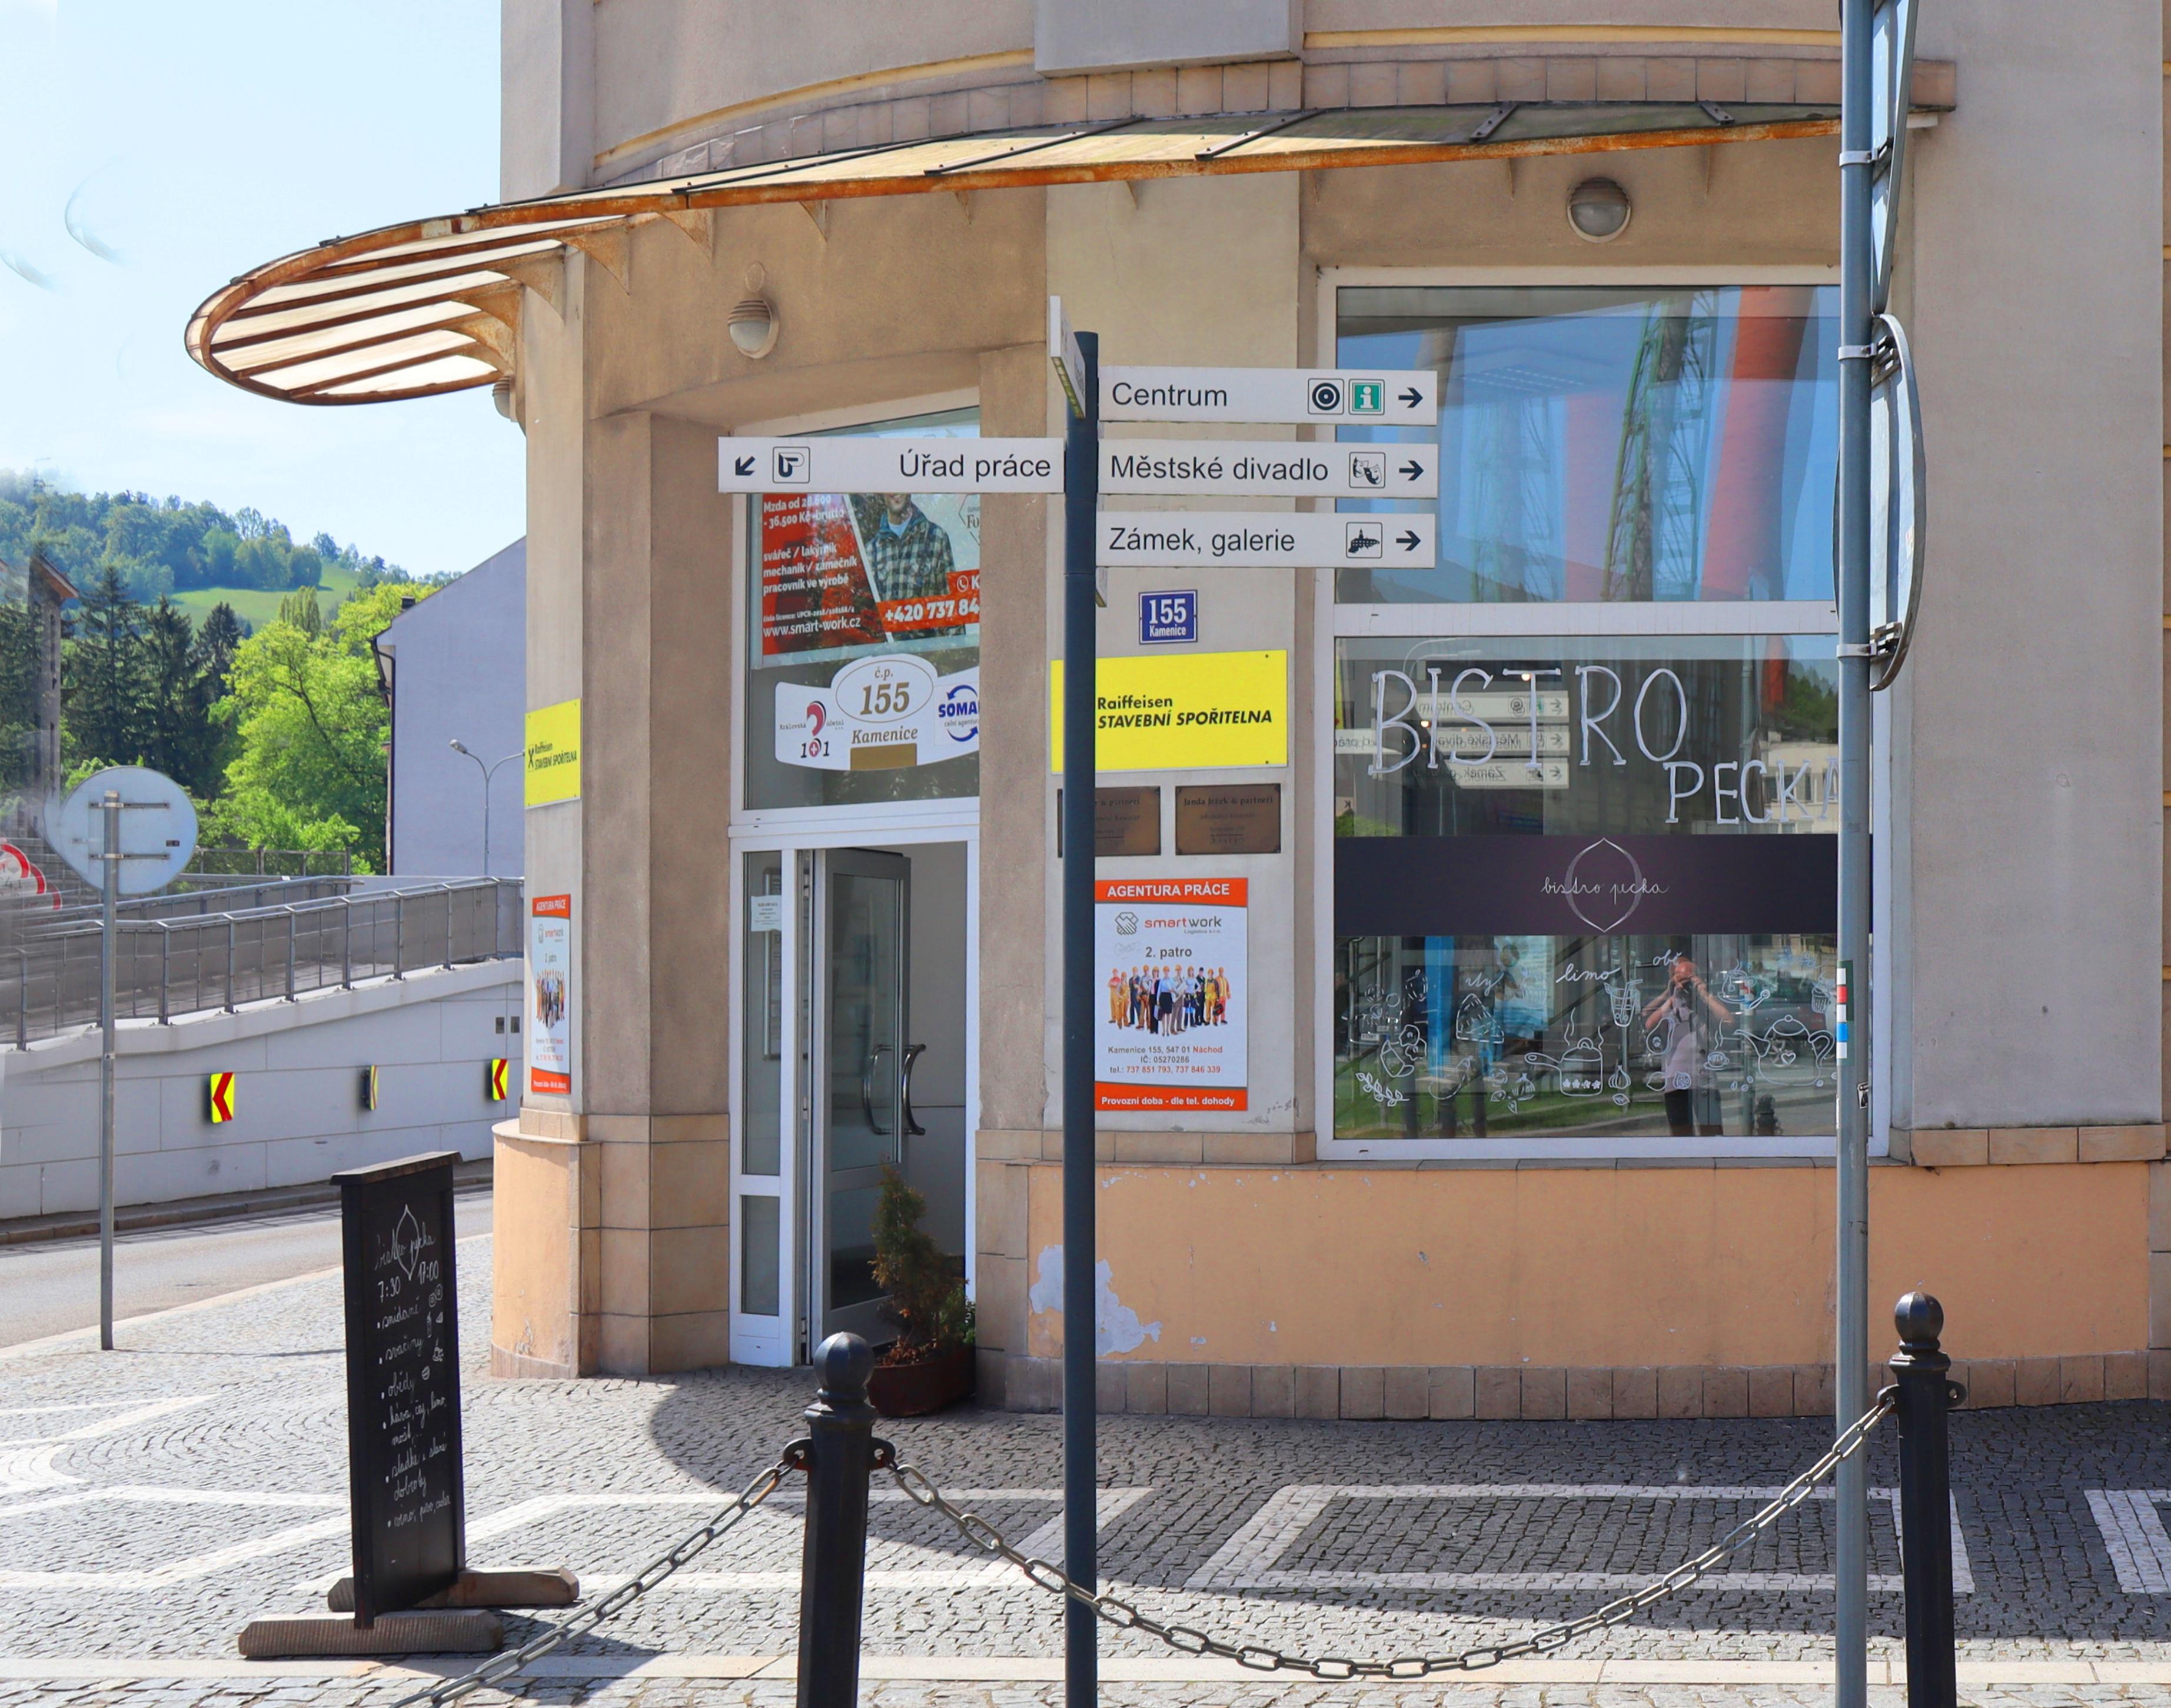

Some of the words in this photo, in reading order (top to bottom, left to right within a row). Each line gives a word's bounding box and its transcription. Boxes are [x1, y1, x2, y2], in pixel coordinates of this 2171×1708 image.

[1111, 381, 1228, 407] Centrum
[899, 448, 964, 477] Úřad
[975, 452, 1051, 482] práce
[1110, 455, 1223, 480] Městské
[1233, 457, 1328, 481] divadlo
[763, 500, 786, 512] Mzda
[788, 497, 801, 510] od
[769, 515, 797, 529] 36.500
[1109, 527, 1202, 555] Zámek,
[1211, 530, 1295, 557] galerie
[763, 548, 792, 562] svářeč
[763, 562, 805, 578] mechanik
[816, 556, 857, 571] zámečník
[763, 577, 806, 597] pracovník
[806, 580, 817, 588] ve
[819, 573, 849, 589] výrobě
[885, 603, 923, 622] +420
[926, 600, 955, 619] 737
[1148, 598, 1187, 625] 155
[763, 616, 861, 638] www.smart-work.cz
[1149, 624, 1186, 637] Kamenice
[874, 665, 893, 679] č.p.
[859, 682, 910, 715] 155
[1098, 694, 1173, 710] Raiffeisen
[938, 701, 980, 718] SOMA
[1098, 710, 1171, 728] STAVEBNÍ
[1176, 707, 1272, 726] SPOŘITELNA
[1368, 665, 1689, 776] BISTRO
[852, 725, 918, 744] Kamenice
[1184, 797, 1206, 806] Janda
[1240, 795, 1274, 806] partneři
[1107, 885, 1181, 897] AGENTURA
[1184, 881, 1230, 895] PRÁCE
[1541, 876, 1605, 894] bistro
[1610, 877, 1670, 906] pecka
[1144, 915, 1222, 929] smartwork
[1145, 947, 1156, 958] 2.
[1159, 946, 1192, 960] patro
[1555, 963, 1621, 984] limo
[1141, 1055, 1151, 1063] IČ:
[1148, 1046, 1163, 1054] 155,
[1158, 1066, 1173, 1074] 793,
[1101, 1096, 1139, 1106] Provozní
[1141, 1096, 1163, 1106] doba
[1171, 1096, 1183, 1105] dle
[1186, 1096, 1200, 1105] tel.
[1202, 1096, 1235, 1107] dohody
[378, 1276, 401, 1303] 7:30
[417, 1260, 440, 1284] 17:00
